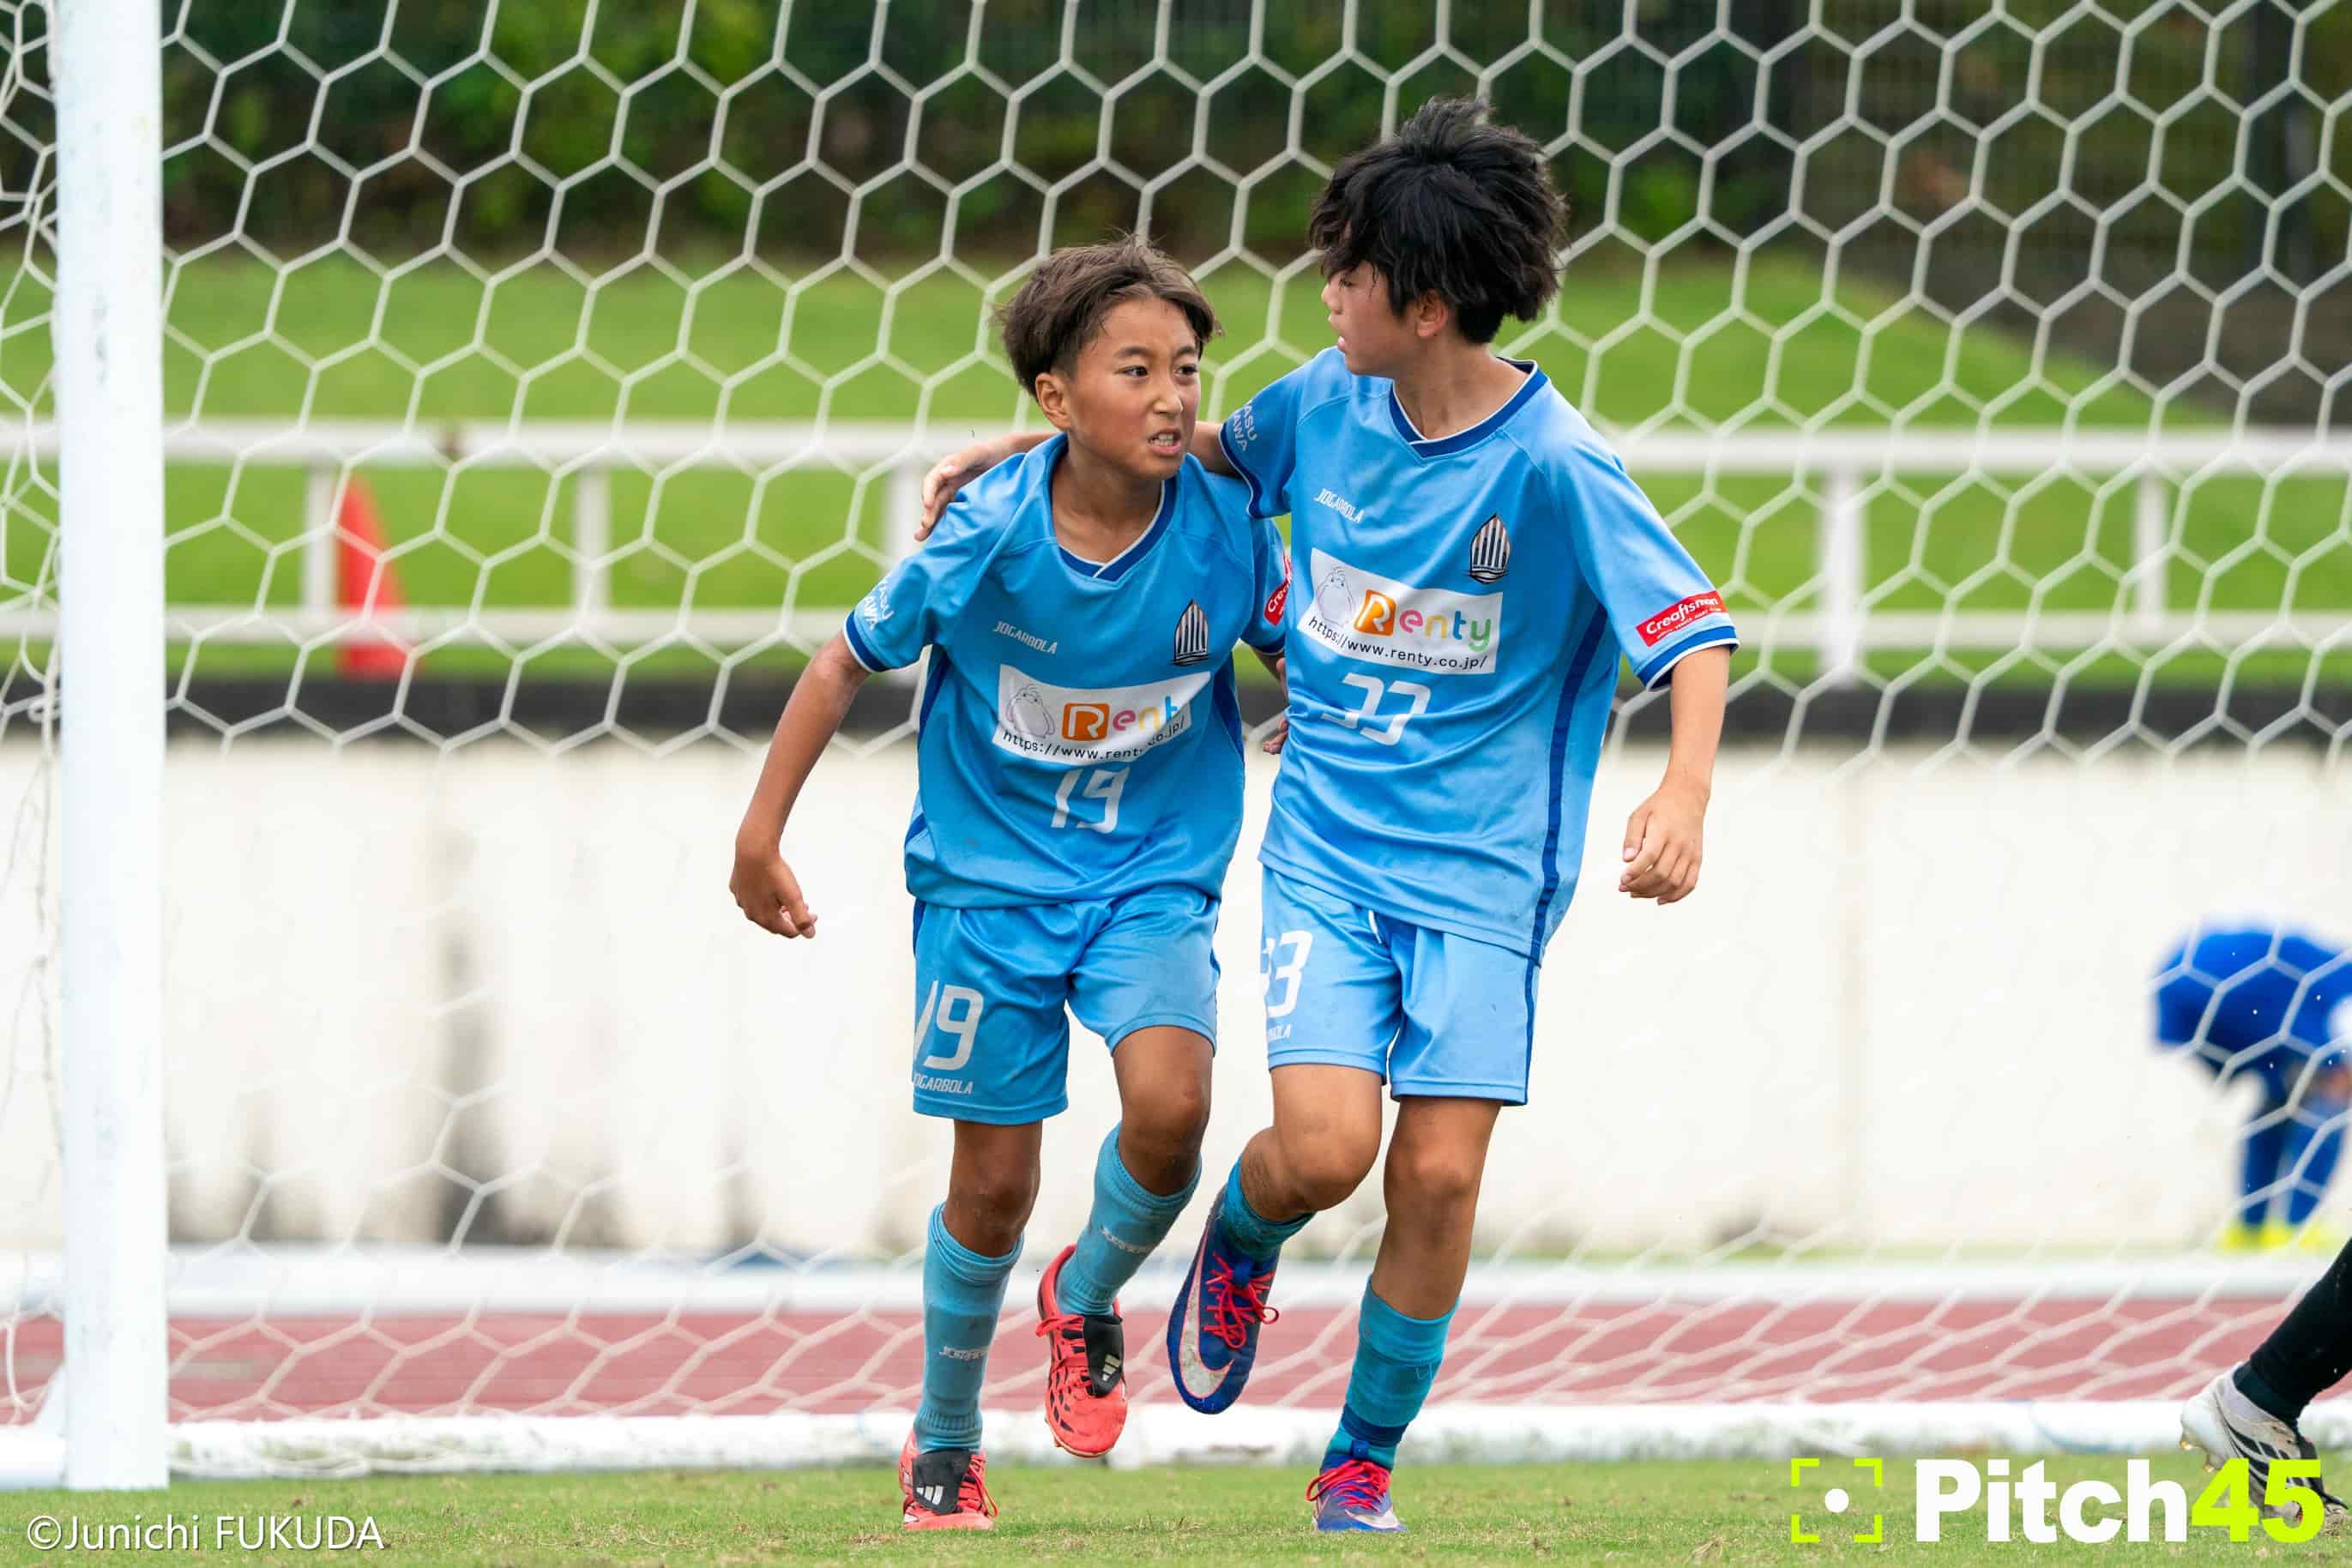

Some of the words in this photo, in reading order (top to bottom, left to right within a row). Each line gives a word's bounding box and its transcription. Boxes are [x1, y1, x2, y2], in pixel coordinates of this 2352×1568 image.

[1308, 616, 1487, 671] https://www.renty.co.jp/
[1354, 590, 1491, 653] Renty
[1064, 696, 1179, 740] Rent
[1050, 767, 1131, 835] 19
[913, 1072, 974, 1095] OGARBOLA
